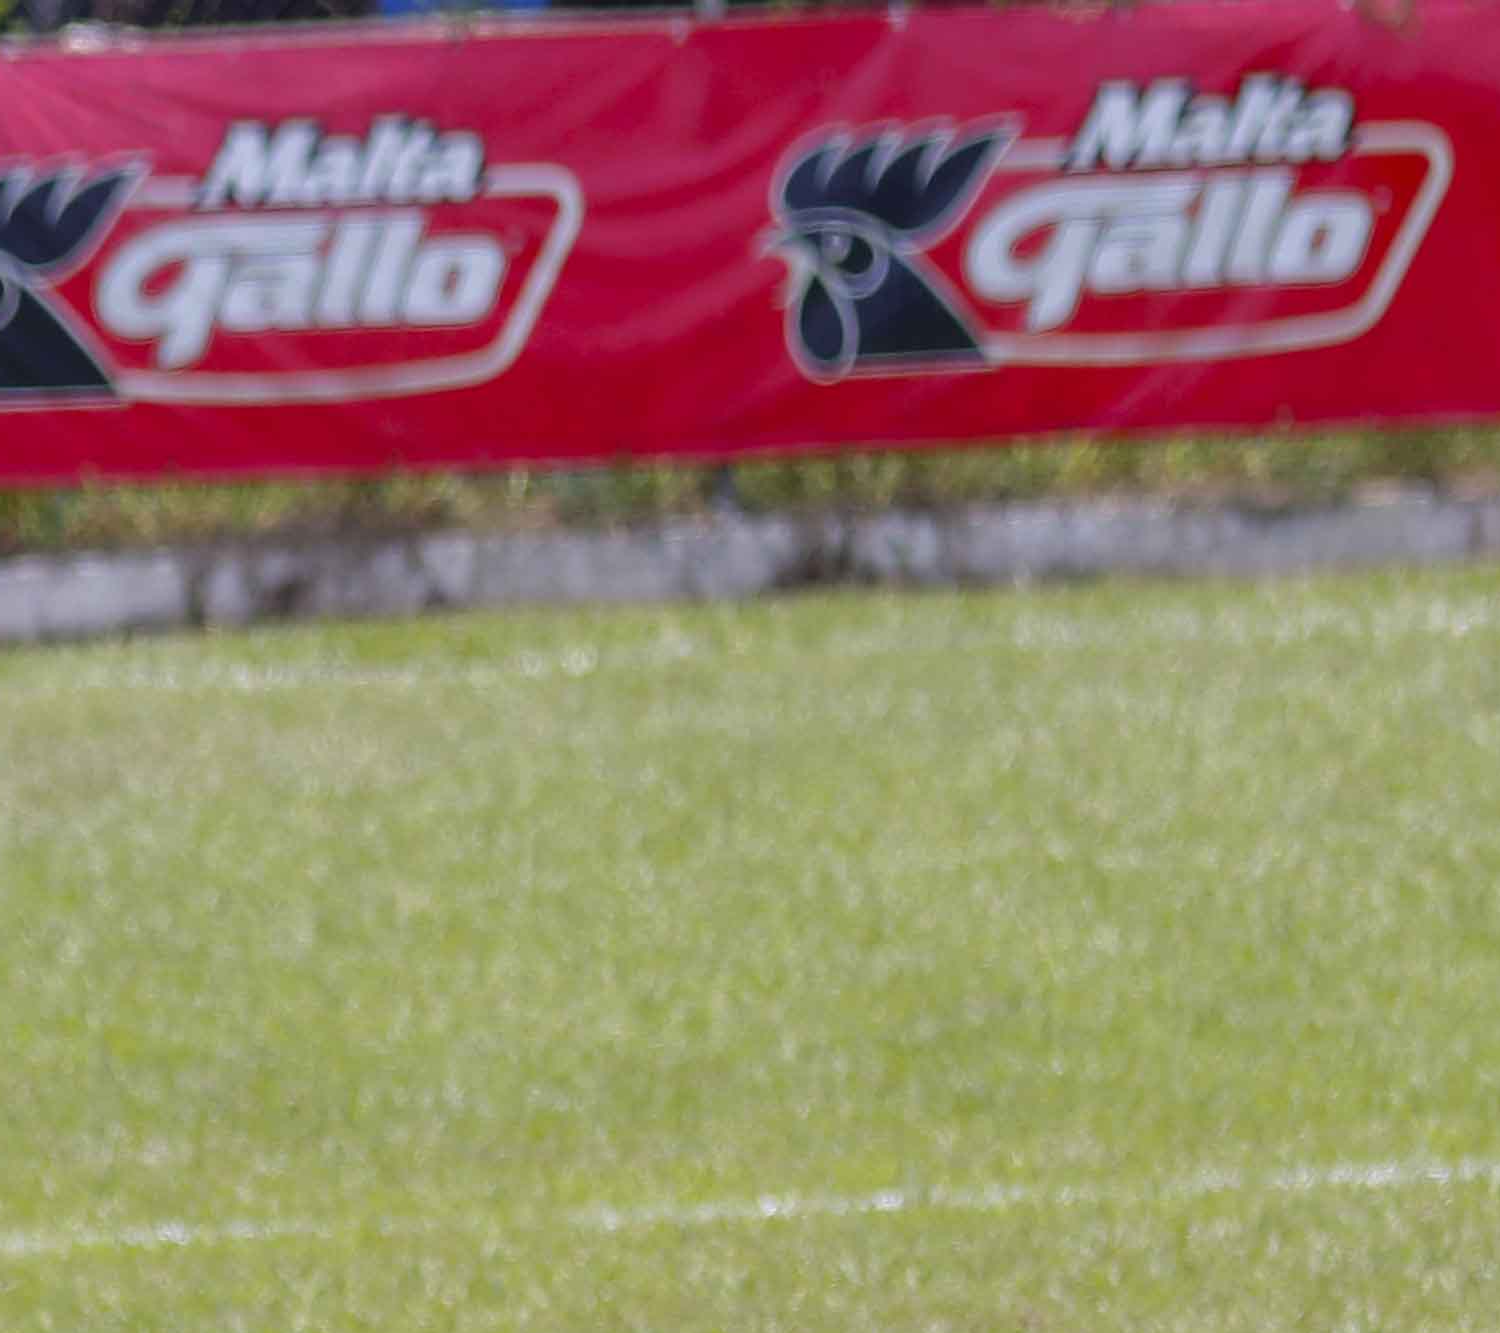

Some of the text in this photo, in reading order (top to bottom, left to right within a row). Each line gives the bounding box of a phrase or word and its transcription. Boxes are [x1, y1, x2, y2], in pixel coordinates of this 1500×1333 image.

[198, 111, 487, 210] Malta
[1062, 74, 1356, 171] Malta
[94, 211, 507, 370] Gallo
[963, 169, 1374, 334] Gallo
